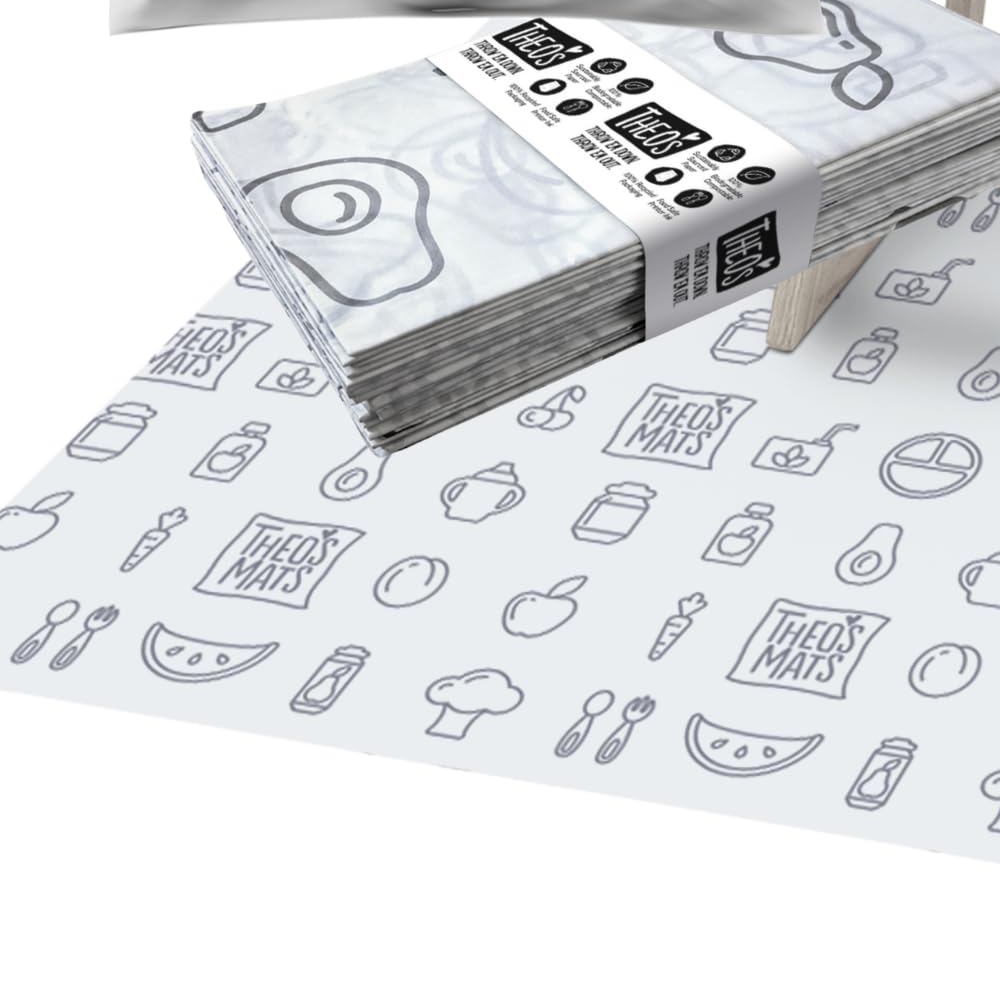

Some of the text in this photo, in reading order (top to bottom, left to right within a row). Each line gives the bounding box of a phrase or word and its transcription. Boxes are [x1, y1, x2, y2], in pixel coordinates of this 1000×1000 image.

[624, 423, 715, 455] MATS
[218, 556, 313, 593] MATS
[750, 642, 843, 682] MATS
